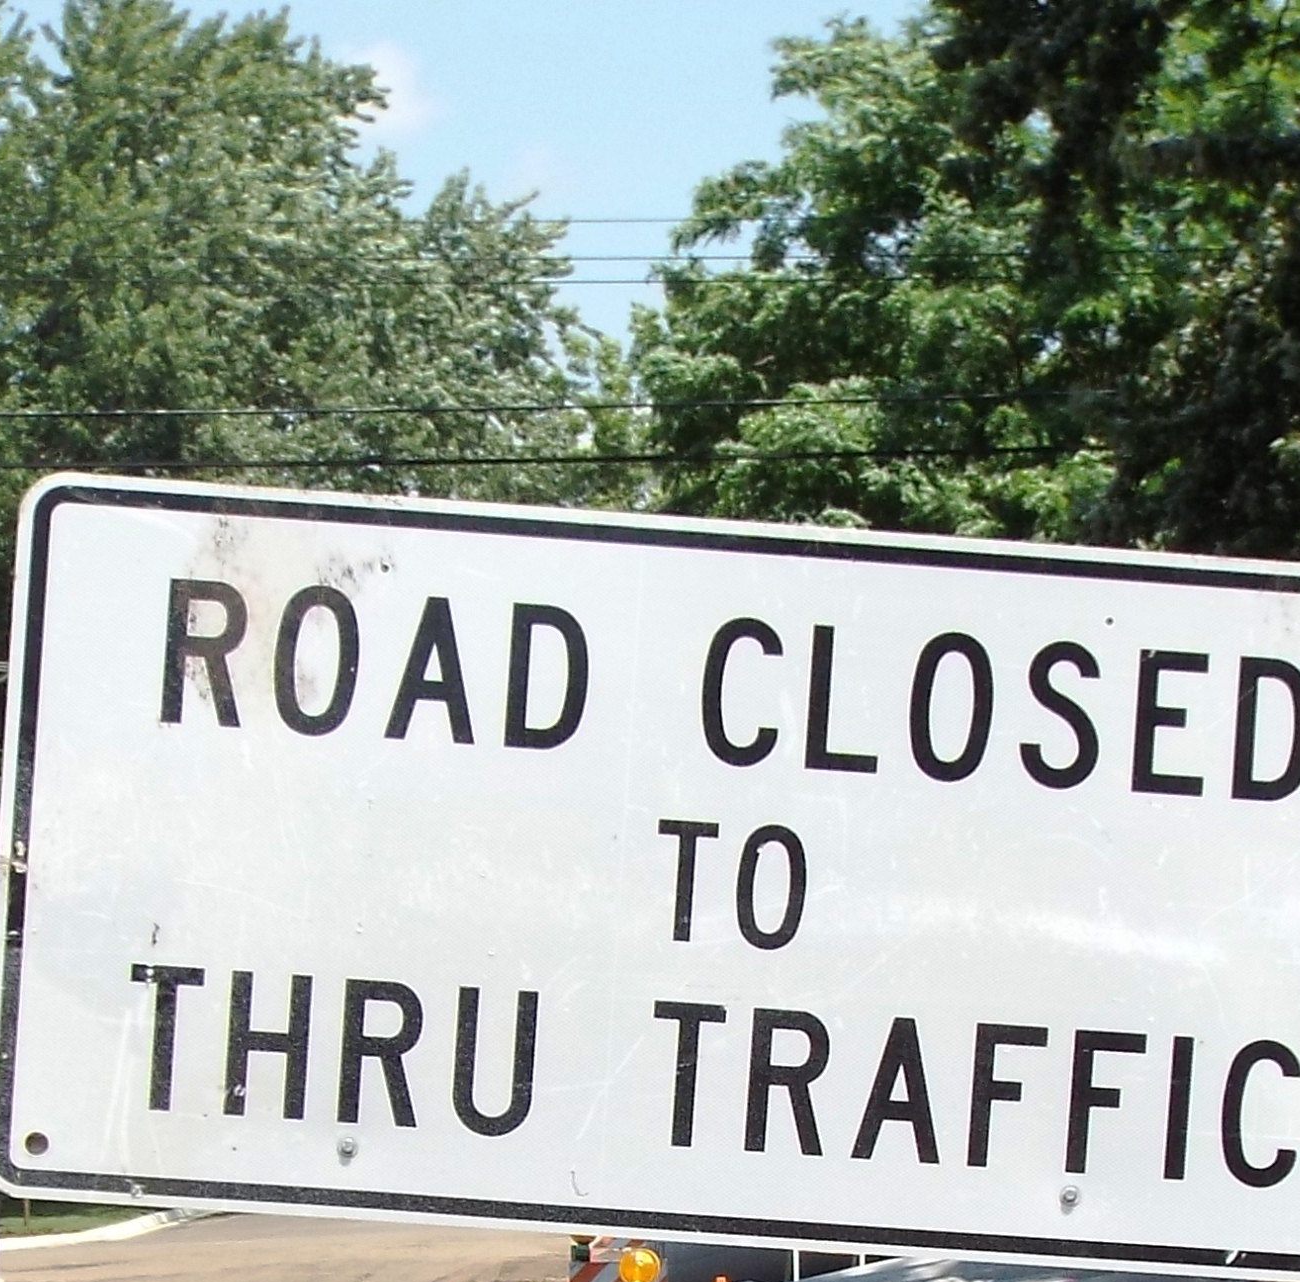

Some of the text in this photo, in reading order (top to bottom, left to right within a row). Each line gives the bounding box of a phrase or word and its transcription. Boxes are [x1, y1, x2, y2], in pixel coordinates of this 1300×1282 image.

[162, 579, 588, 748] ROAD
[659, 820, 806, 949] TO
[132, 964, 1300, 1187] THRU TRAFFIC
